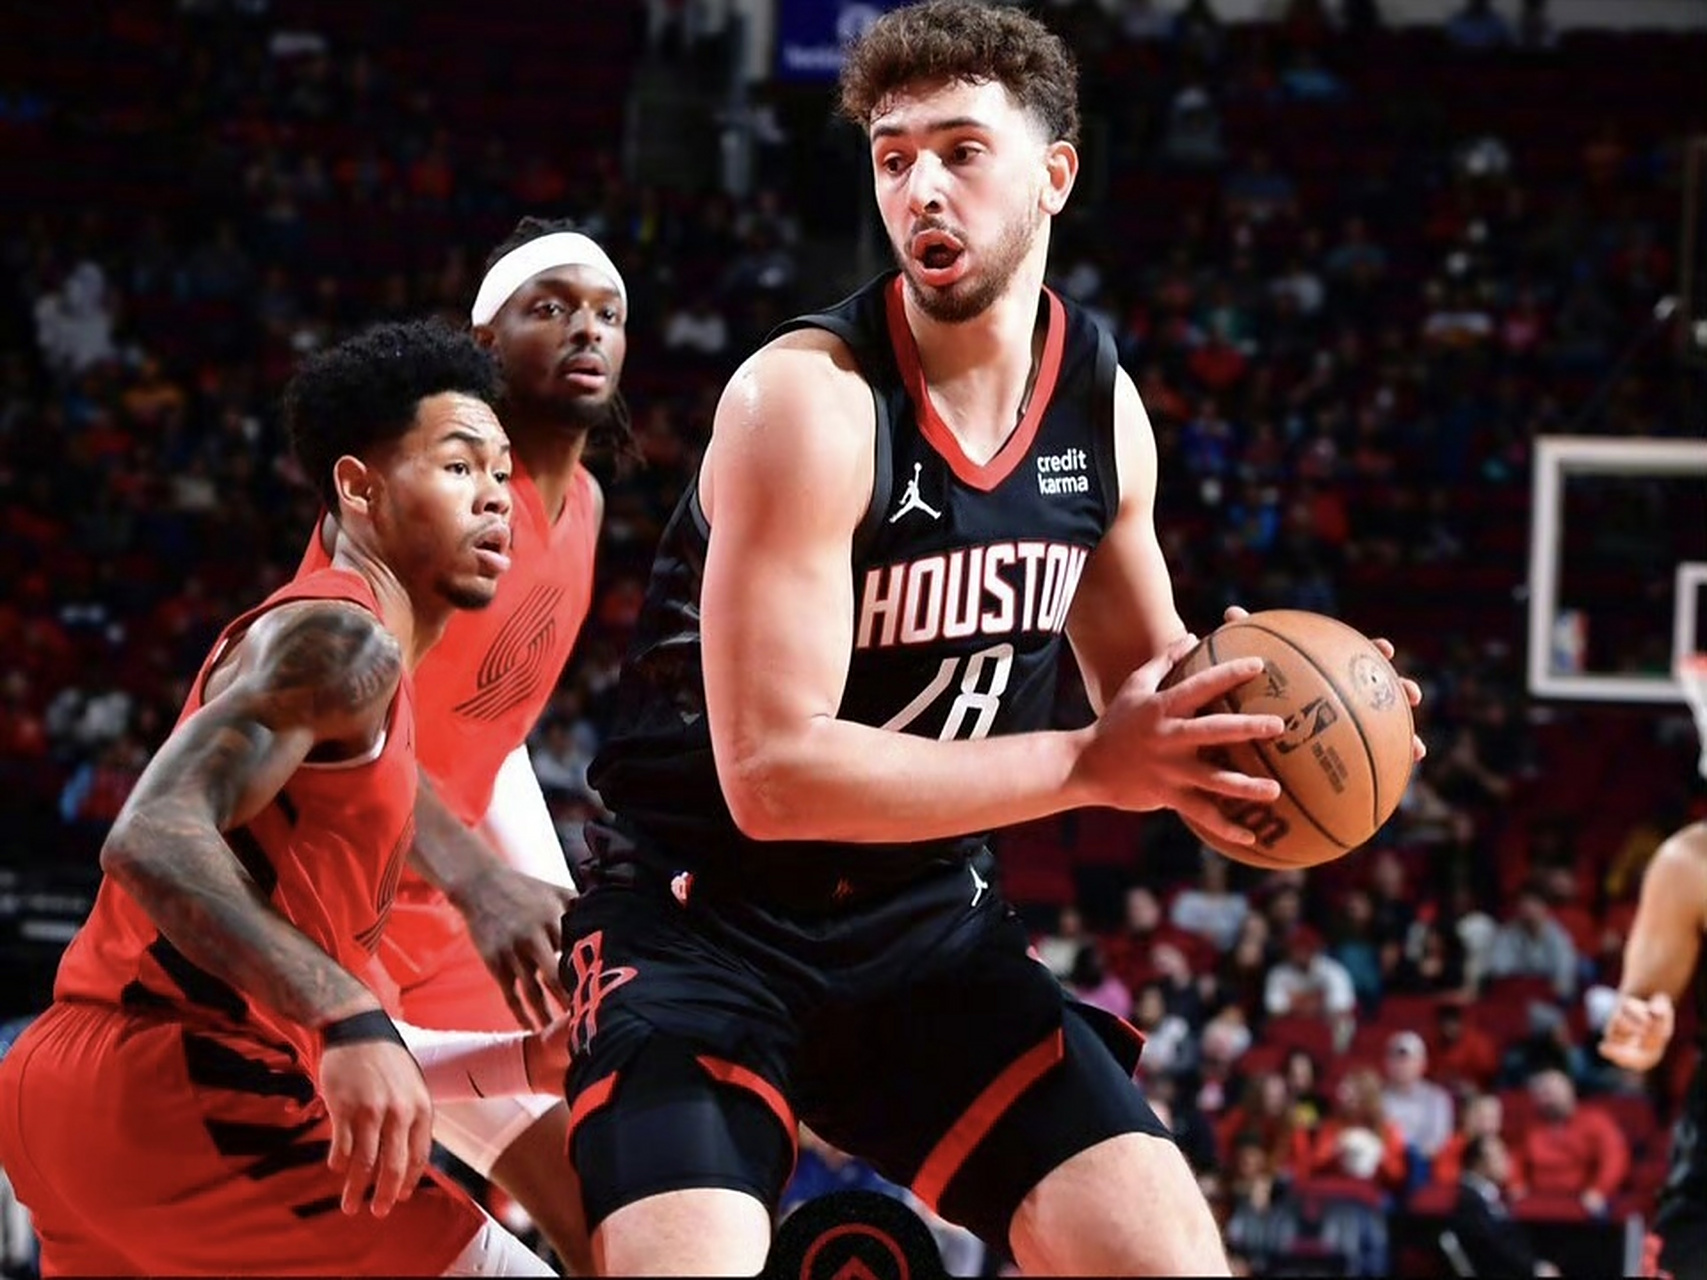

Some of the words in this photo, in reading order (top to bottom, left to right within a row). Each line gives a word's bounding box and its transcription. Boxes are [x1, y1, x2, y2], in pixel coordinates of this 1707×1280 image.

[1037, 449, 1087, 472] credit
[1037, 472, 1089, 495] karma
[856, 541, 1089, 649] HOUSTON
